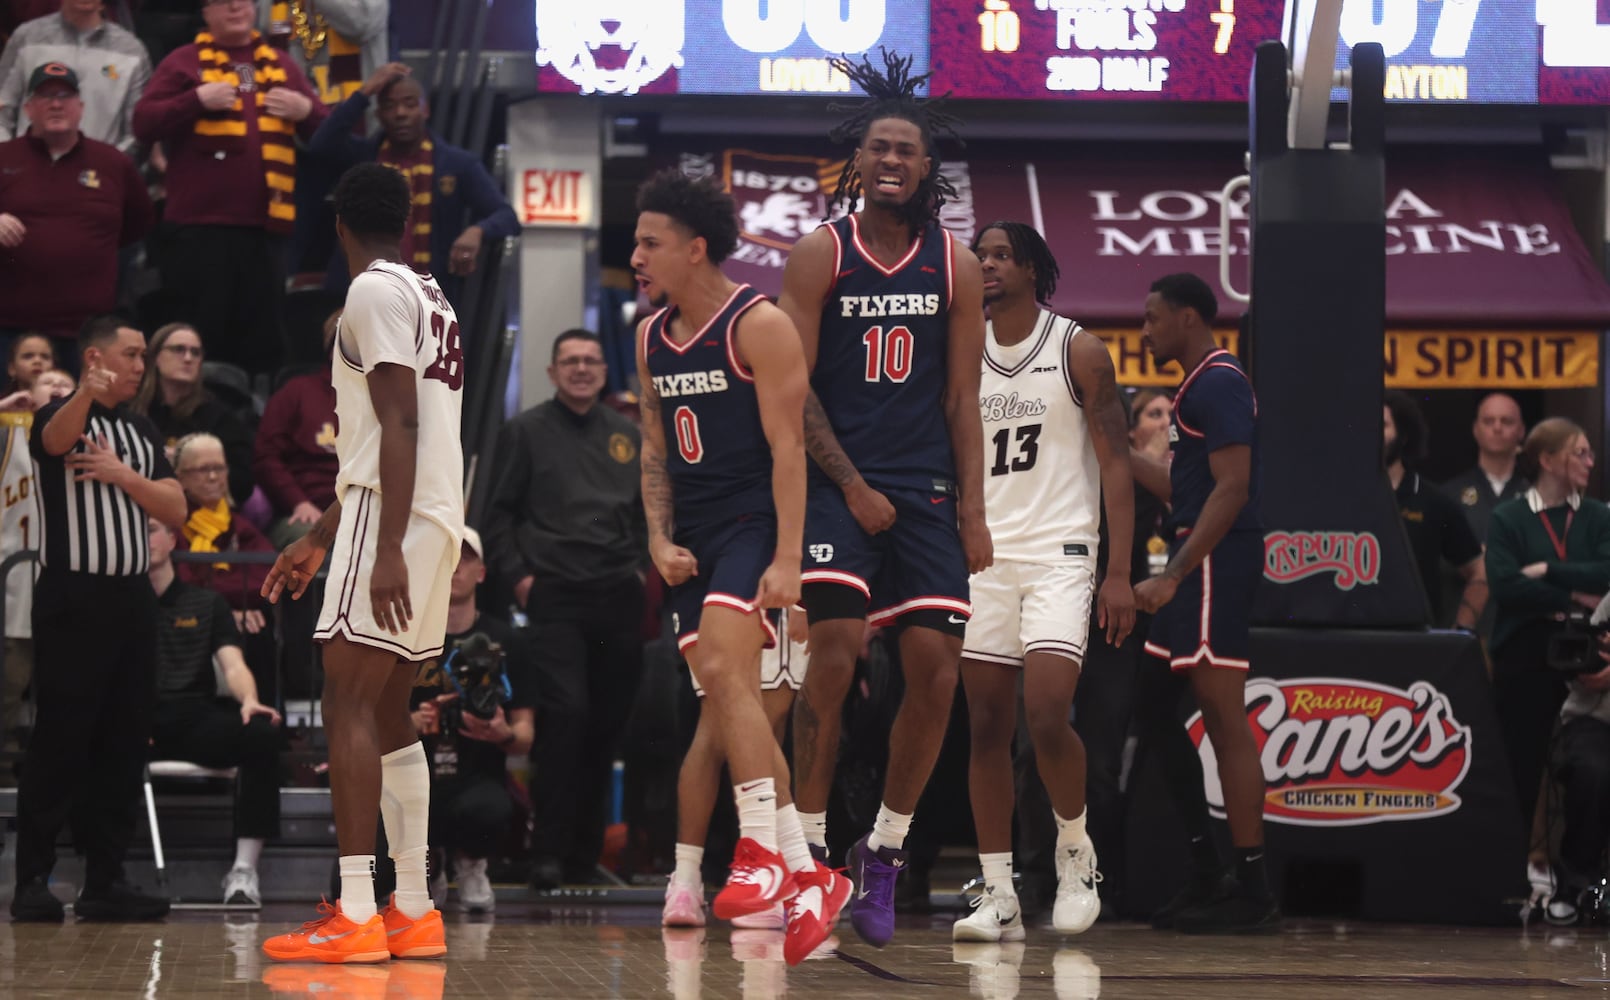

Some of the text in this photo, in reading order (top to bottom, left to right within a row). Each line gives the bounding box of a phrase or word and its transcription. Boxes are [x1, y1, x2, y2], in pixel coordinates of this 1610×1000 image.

[979, 10, 1020, 53] 10
[1056, 8, 1157, 50] FOULS
[1210, 12, 1236, 54] 7
[1102, 56, 1170, 91] HALF
[1383, 65, 1467, 100] AYTON
[523, 168, 584, 210] EXIT
[732, 169, 819, 193] 1870
[839, 293, 940, 317] FLYERS
[422, 310, 464, 391] 28
[862, 325, 914, 383] 10
[1415, 336, 1576, 379] SPIRIT
[673, 405, 704, 464] 0
[991, 423, 1042, 476] 13
[1263, 530, 1380, 591] CAPUTO
[1290, 688, 1383, 717] Raising
[1283, 790, 1436, 808] CHICKEN FINGERS
